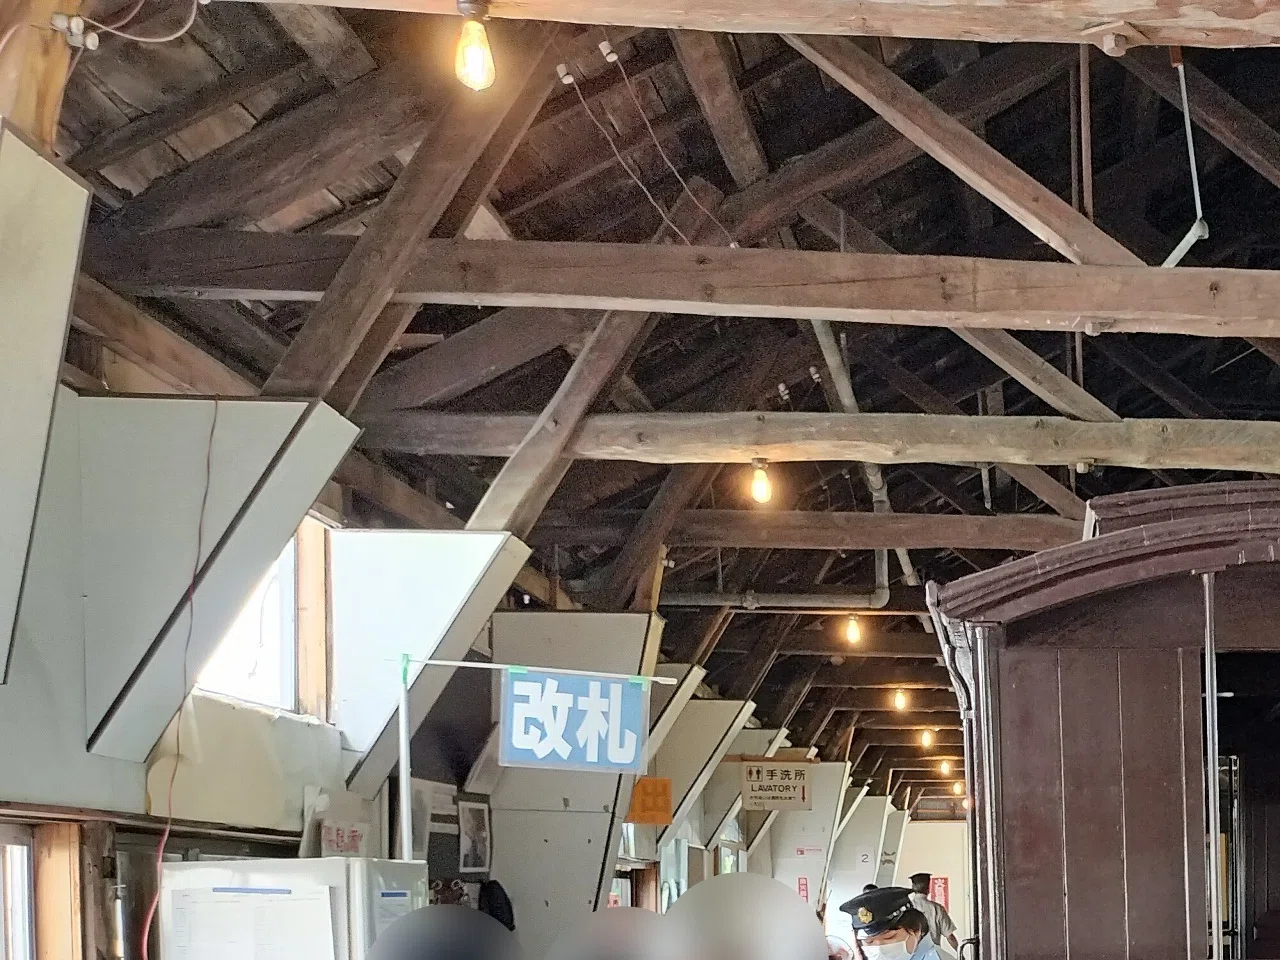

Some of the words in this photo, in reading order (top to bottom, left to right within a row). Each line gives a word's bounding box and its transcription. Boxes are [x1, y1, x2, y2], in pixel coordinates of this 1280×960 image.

[511, 677, 638, 764] 改札
[765, 768, 806, 781] 手洗所
[750, 784, 798, 793] LAVATORY
[861, 853, 870, 863] 2
